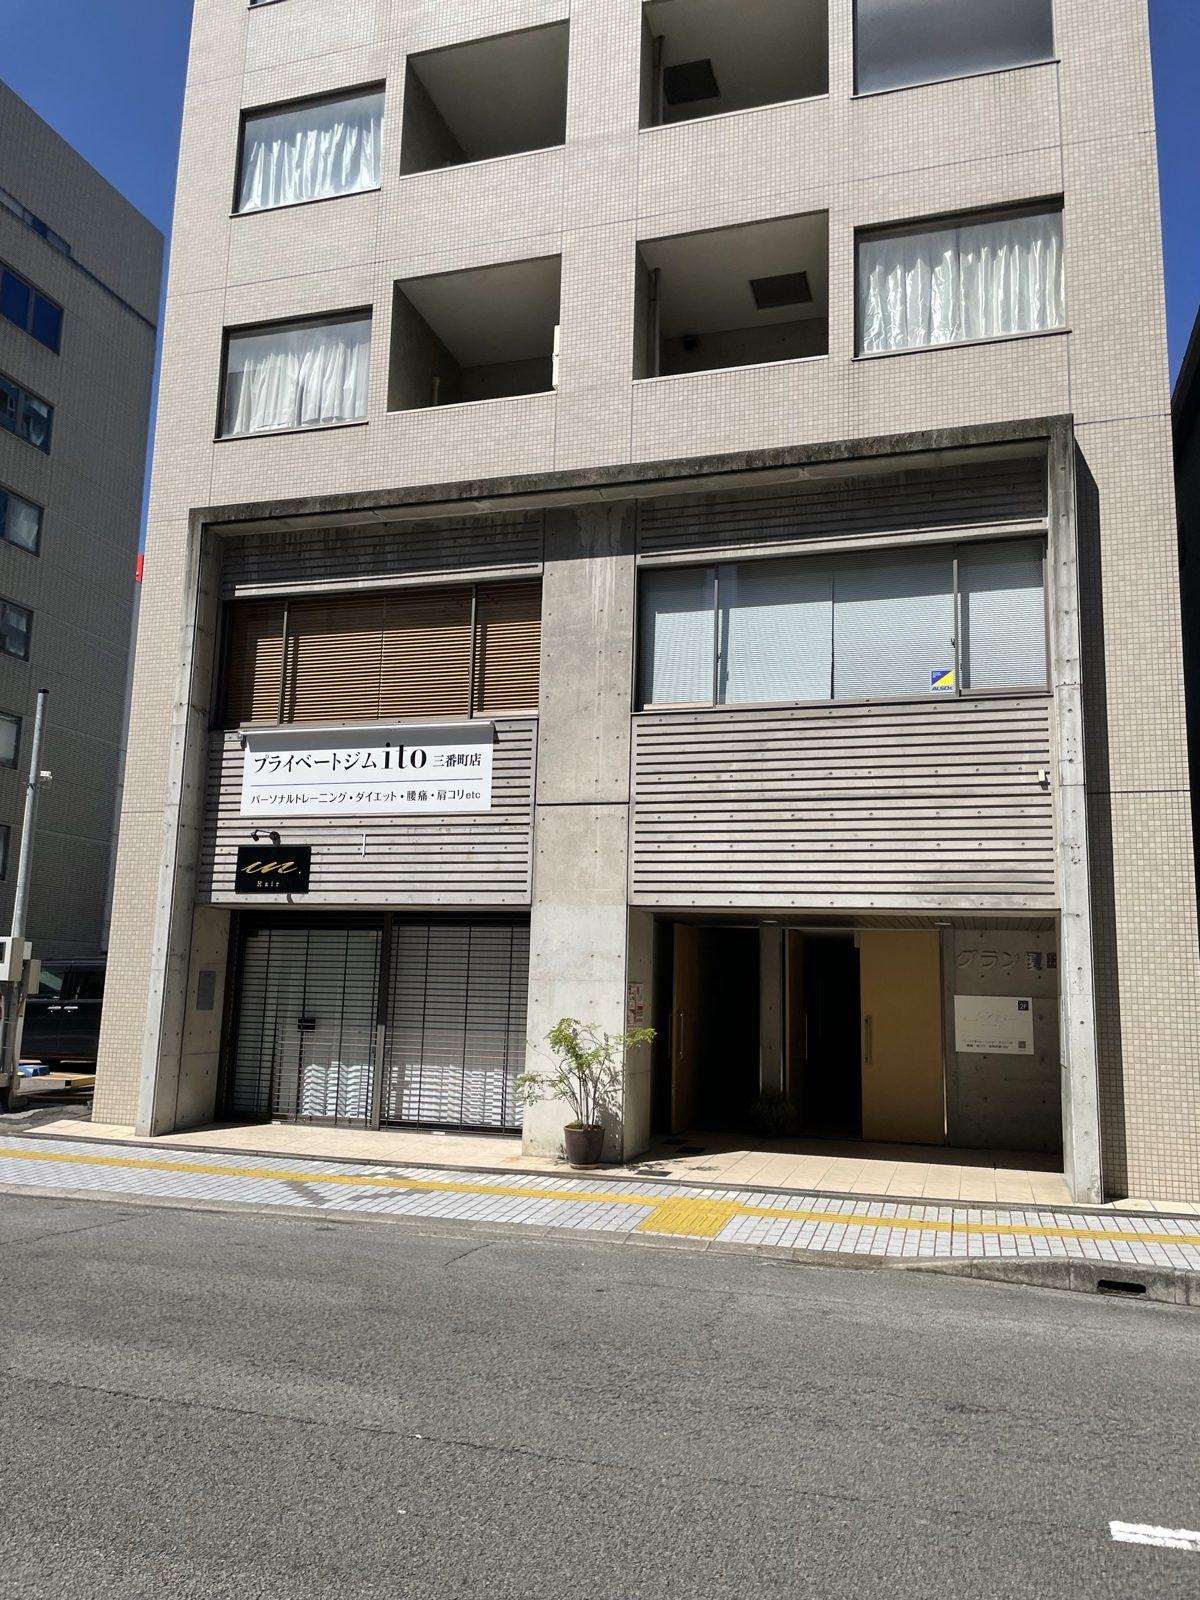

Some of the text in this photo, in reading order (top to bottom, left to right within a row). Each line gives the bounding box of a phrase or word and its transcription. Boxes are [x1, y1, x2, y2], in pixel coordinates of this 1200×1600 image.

[254, 742, 482, 774] プライベートジム ito 三番町店
[256, 880, 280, 888] Hair
